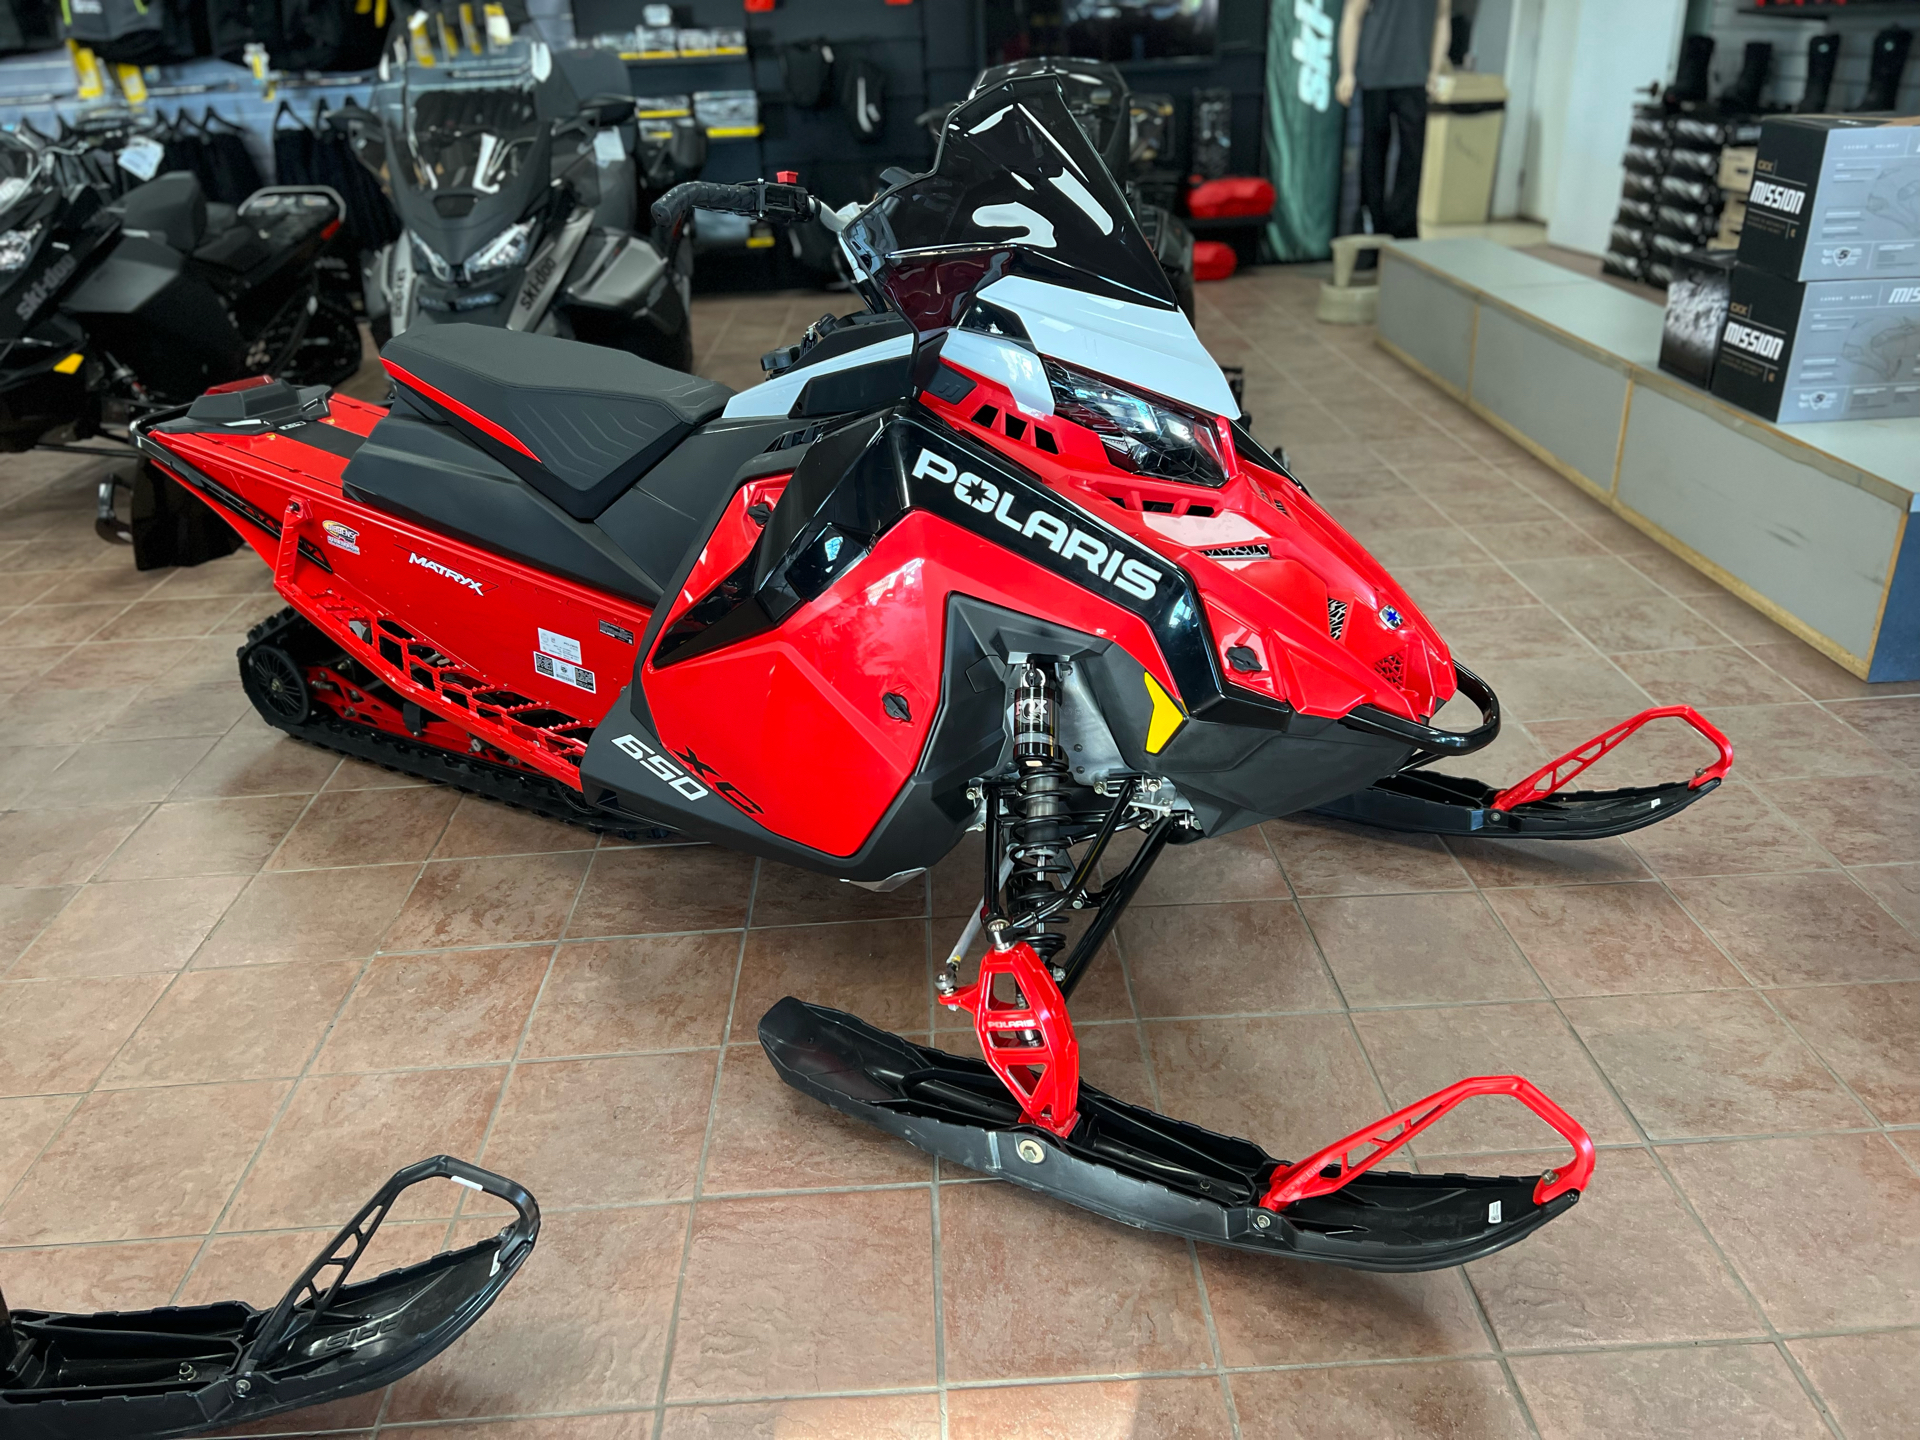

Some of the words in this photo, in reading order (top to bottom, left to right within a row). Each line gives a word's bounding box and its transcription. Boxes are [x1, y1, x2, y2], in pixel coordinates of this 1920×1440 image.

[1750, 180, 1806, 215] MISSION
[519, 256, 556, 312] ski-doo
[1723, 321, 1785, 361] MISSION
[911, 447, 1163, 601] POLARIS
[408, 552, 485, 597] MATRYX
[1015, 698, 1048, 720] FOX
[610, 733, 709, 802] 650
[670, 744, 765, 815] XC
[986, 1019, 1037, 1029] POLARIS
